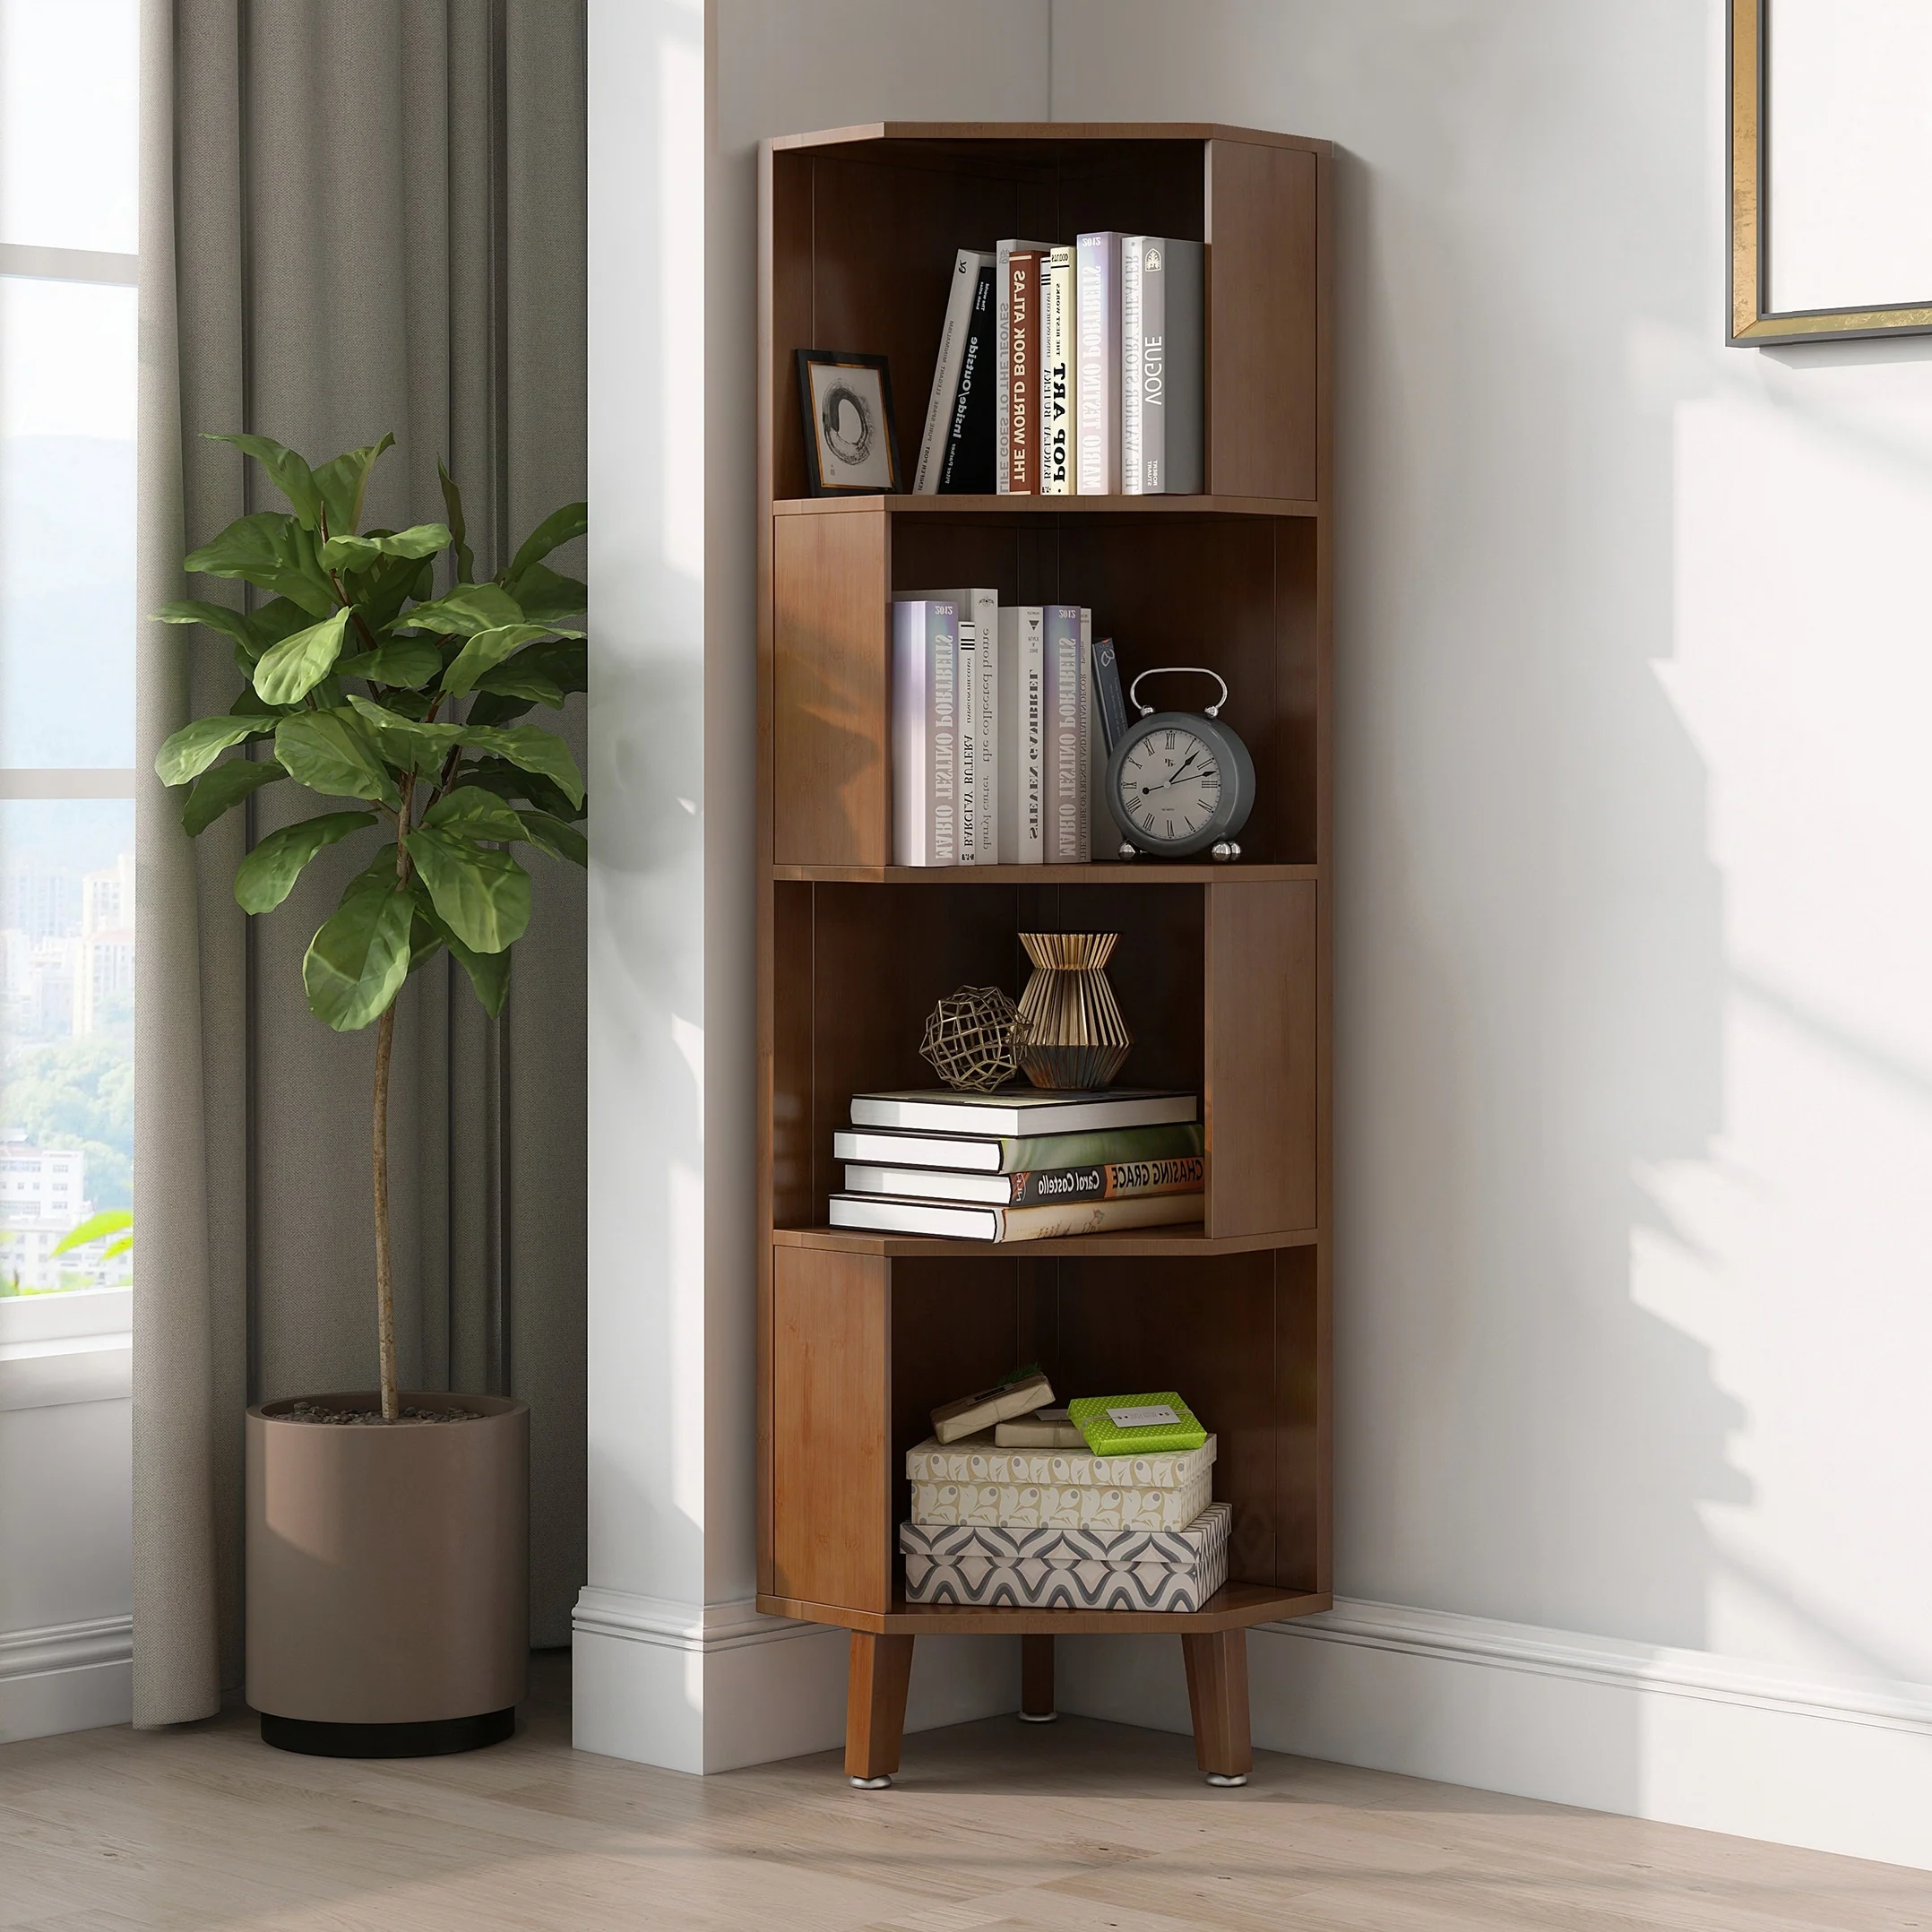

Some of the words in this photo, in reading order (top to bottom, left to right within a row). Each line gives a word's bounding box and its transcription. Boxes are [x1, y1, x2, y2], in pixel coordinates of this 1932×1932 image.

[1144, 738, 1155, 756] XI
[1165, 734, 1175, 749] XII
[1185, 740, 1195, 755] I
[1129, 757, 1143, 769] X
[1198, 759, 1212, 770] II
[1143, 813, 1155, 832] VII
[1167, 820, 1175, 837] VI
[1185, 816, 1195, 831] V
